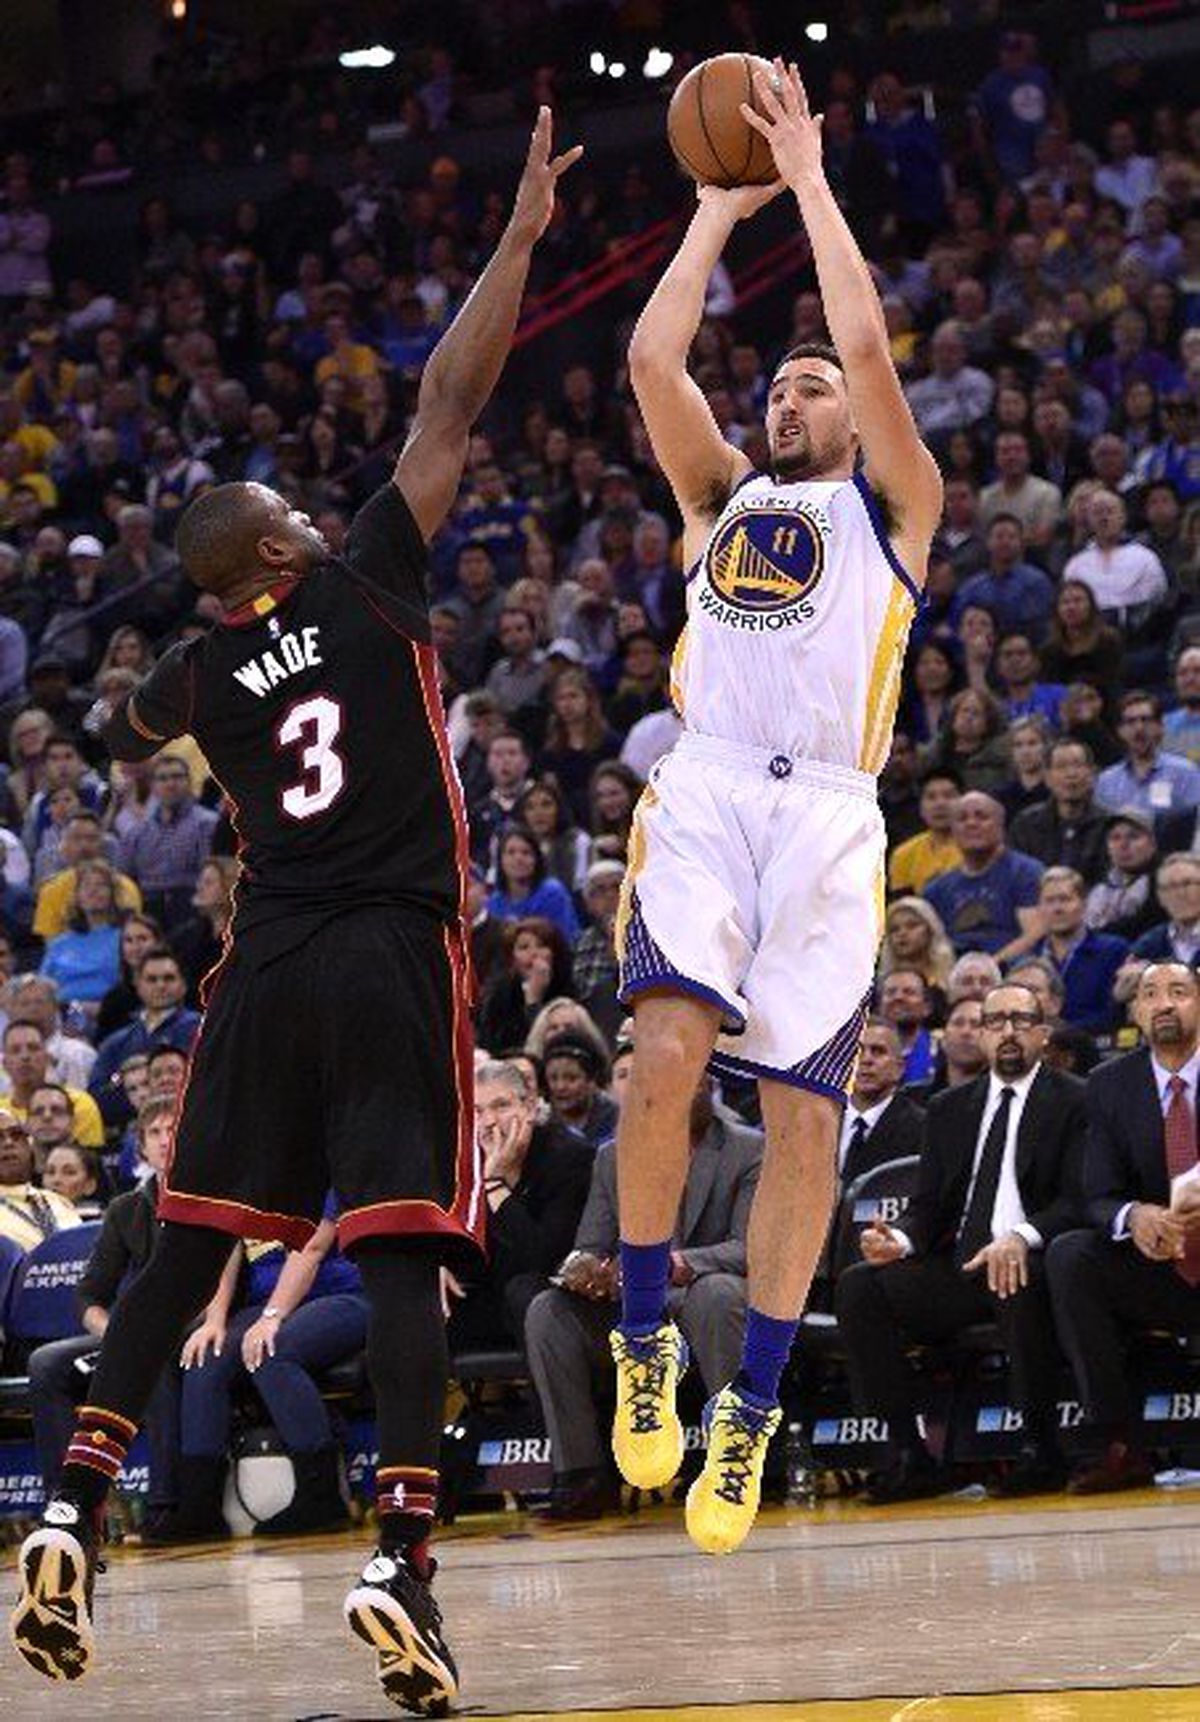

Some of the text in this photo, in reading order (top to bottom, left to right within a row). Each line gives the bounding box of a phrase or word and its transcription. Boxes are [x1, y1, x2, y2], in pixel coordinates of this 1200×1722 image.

[772, 526, 798, 555] 11
[699, 587, 815, 631] WARRIORS
[232, 626, 322, 697] WADE
[278, 694, 345, 821] 3
